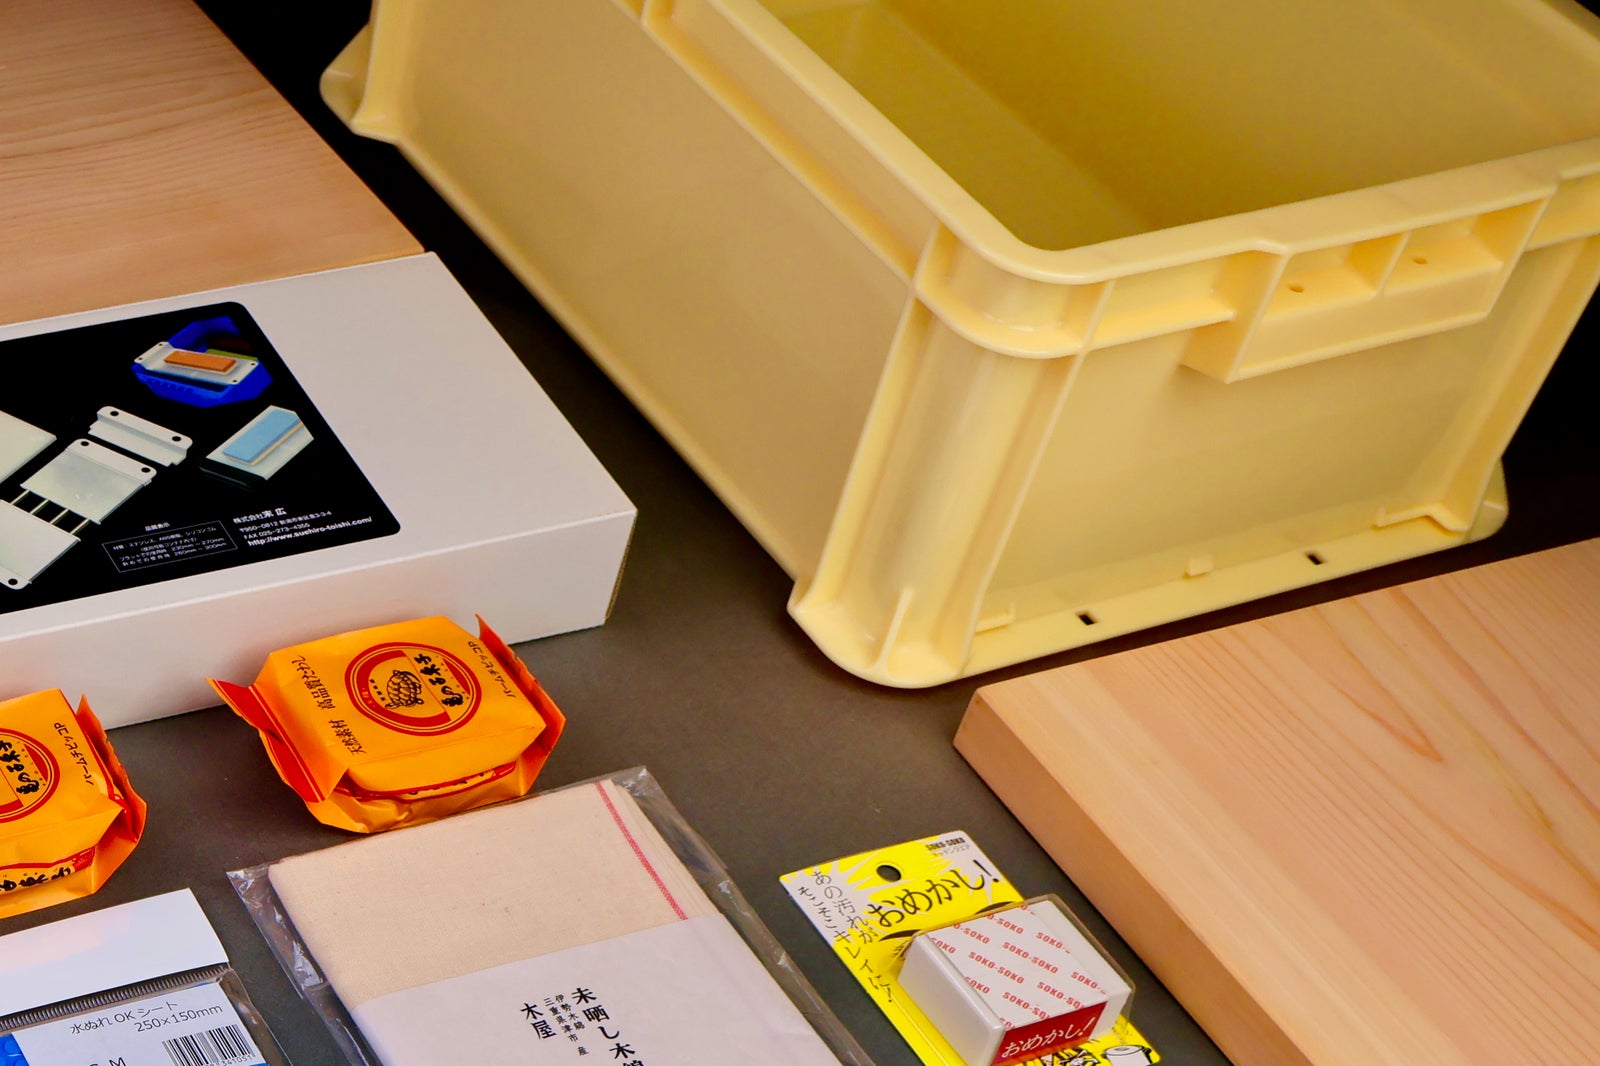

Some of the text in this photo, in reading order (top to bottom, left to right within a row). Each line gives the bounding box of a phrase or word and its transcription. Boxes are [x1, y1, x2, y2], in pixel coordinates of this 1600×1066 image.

[414, 653, 464, 707] 亀の子束子
[291, 655, 368, 756] 天然素材 高品質たわし
[813, 870, 879, 945] あの汚れが
[868, 859, 999, 928] おめかし!
[798, 886, 893, 1003] そこそこキレイに!
[968, 951, 1024, 984] SOKO-SOKO
[1002, 941, 1058, 974] SOKO-SOKO
[521, 1002, 557, 1040] 木屋
[1002, 1016, 1096, 1058] おめかし!
[221, 1055, 253, 1066] 341051
